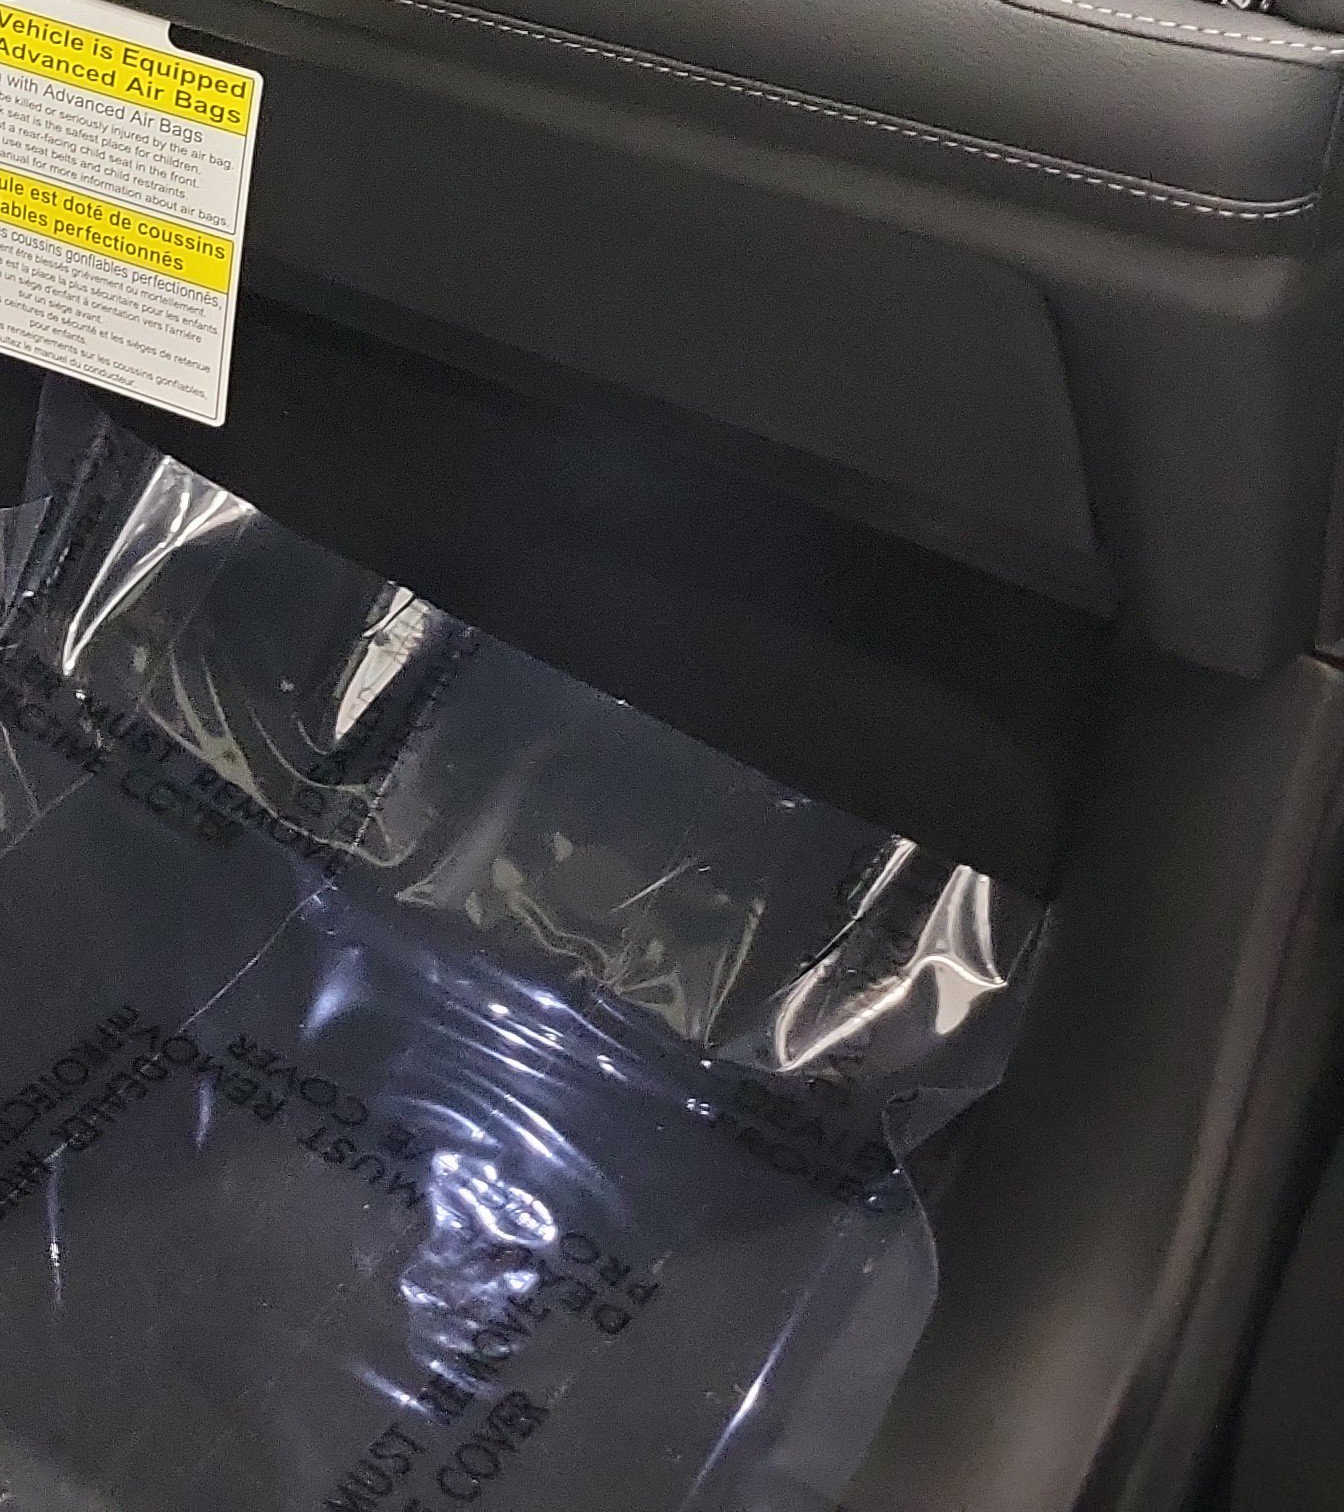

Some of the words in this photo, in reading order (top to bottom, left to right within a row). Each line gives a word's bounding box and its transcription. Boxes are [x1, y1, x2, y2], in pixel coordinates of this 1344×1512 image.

[92, 37, 113, 60] is
[122, 47, 246, 98] Equipped
[6, 74, 38, 94] with
[42, 83, 125, 120] Advanced
[128, 109, 155, 128] Air
[158, 117, 203, 143] Bags
[14, 94, 42, 112] killed
[43, 106, 57, 116] or
[58, 110, 109, 134] seriously
[110, 123, 150, 144] injured
[151, 135, 167, 151] by
[168, 141, 188, 156] the
[190, 149, 207, 161] air
[124, 76, 165, 100] Air
[174, 89, 240, 123] Bags
[1, 136, 22, 148] use
[24, 142, 48, 157] seat
[50, 148, 77, 165] belts
[79, 159, 101, 173] and
[102, 166, 130, 182] child
[6, 109, 30, 123] seat
[31, 115, 42, 127] is
[44, 119, 62, 132] the
[64, 126, 99, 144] safest
[100, 137, 131, 153] place
[134, 145, 151, 158] for
[7, 123, 15, 133] a
[17, 127, 77, 153] rear-facing
[78, 145, 106, 160] child
[108, 154, 133, 169] seat
[134, 160, 146, 173] in
[148, 164, 167, 179] the
[31, 156, 47, 169] for
[48, 164, 77, 180] more
[79, 171, 142, 200] information
[144, 194, 177, 211] about
[179, 204, 196, 216] air
[29, 187, 57, 207] est
[62, 195, 103, 221] doté
[108, 210, 131, 230] de
[137, 222, 225, 259] coussins
[53, 219, 183, 270] perfectionnés
[10, 230, 62, 257] coussins
[64, 249, 128, 278] gonflables
[227, 1034, 369, 1126] COVER
[296, 1126, 425, 1210] MUST
[436, 1390, 550, 1502] COVER
